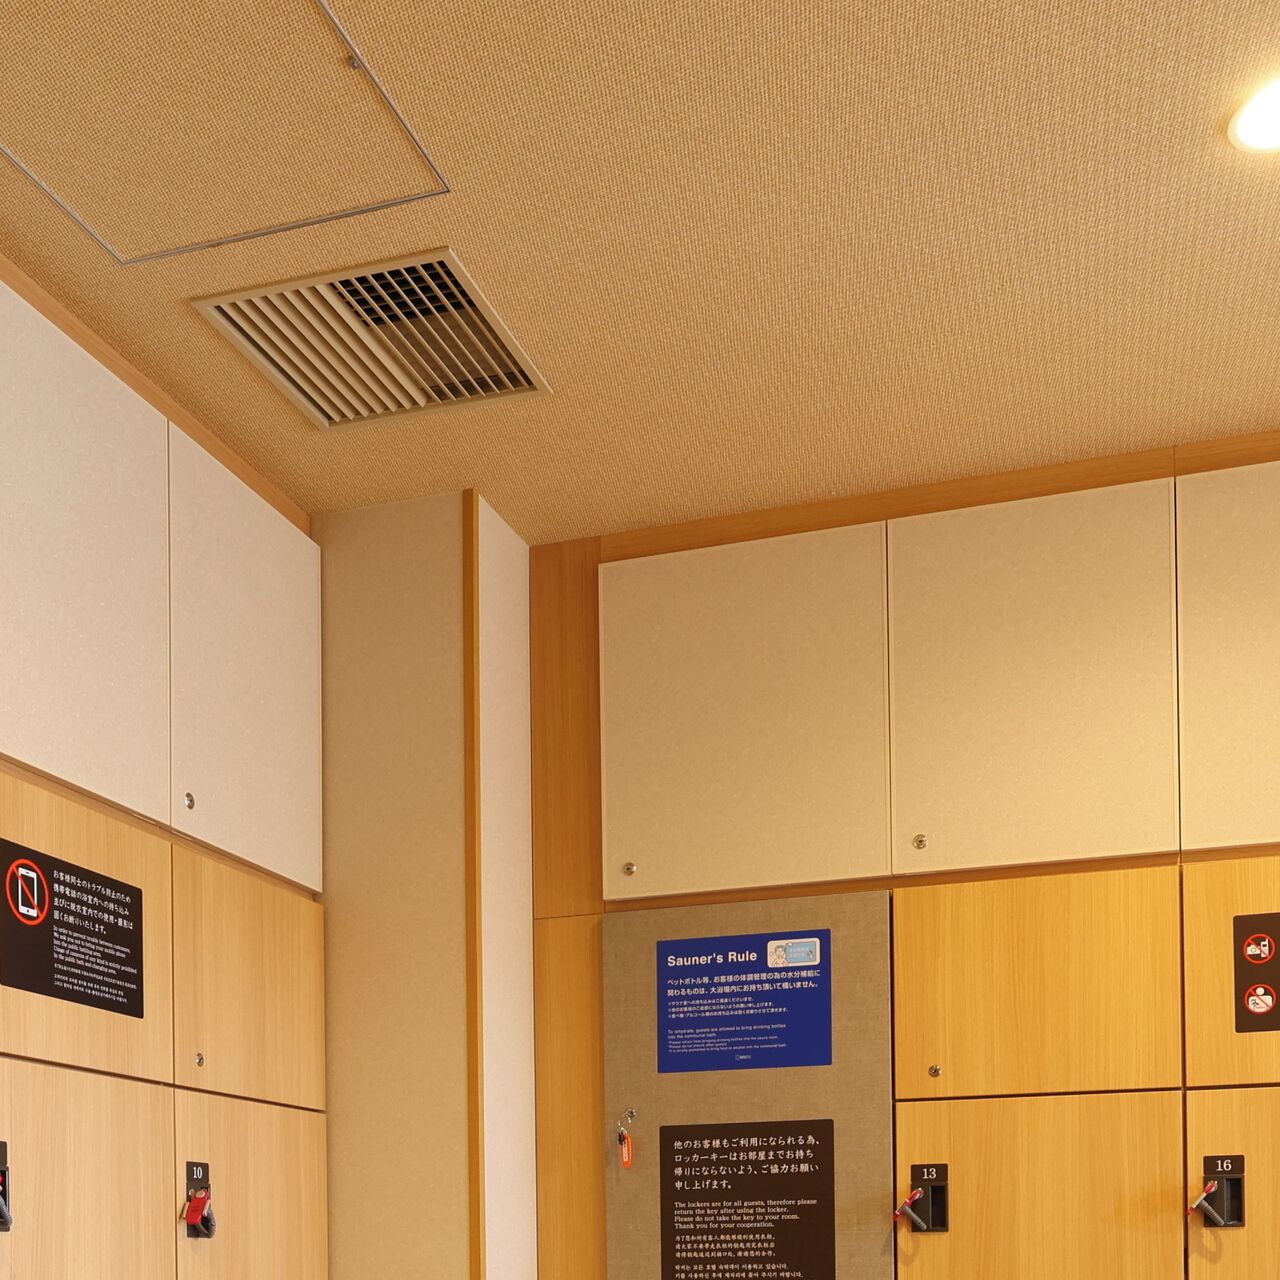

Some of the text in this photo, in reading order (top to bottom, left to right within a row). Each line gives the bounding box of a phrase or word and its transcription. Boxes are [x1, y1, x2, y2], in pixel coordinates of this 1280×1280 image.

[667, 951, 757, 966] Sauner's Rule
[674, 1135, 819, 1149] 他のお客様もご利用になられる為、
[675, 1149, 814, 1162] ロッカーキーはお部屋までお持ち
[674, 1163, 819, 1176] 帰りにならないよう、ご協力お願い
[1216, 1160, 1232, 1170] 16
[194, 1166, 202, 1178] 10
[924, 1168, 936, 1178] 13
[675, 1180, 731, 1190] 申し上げます。
